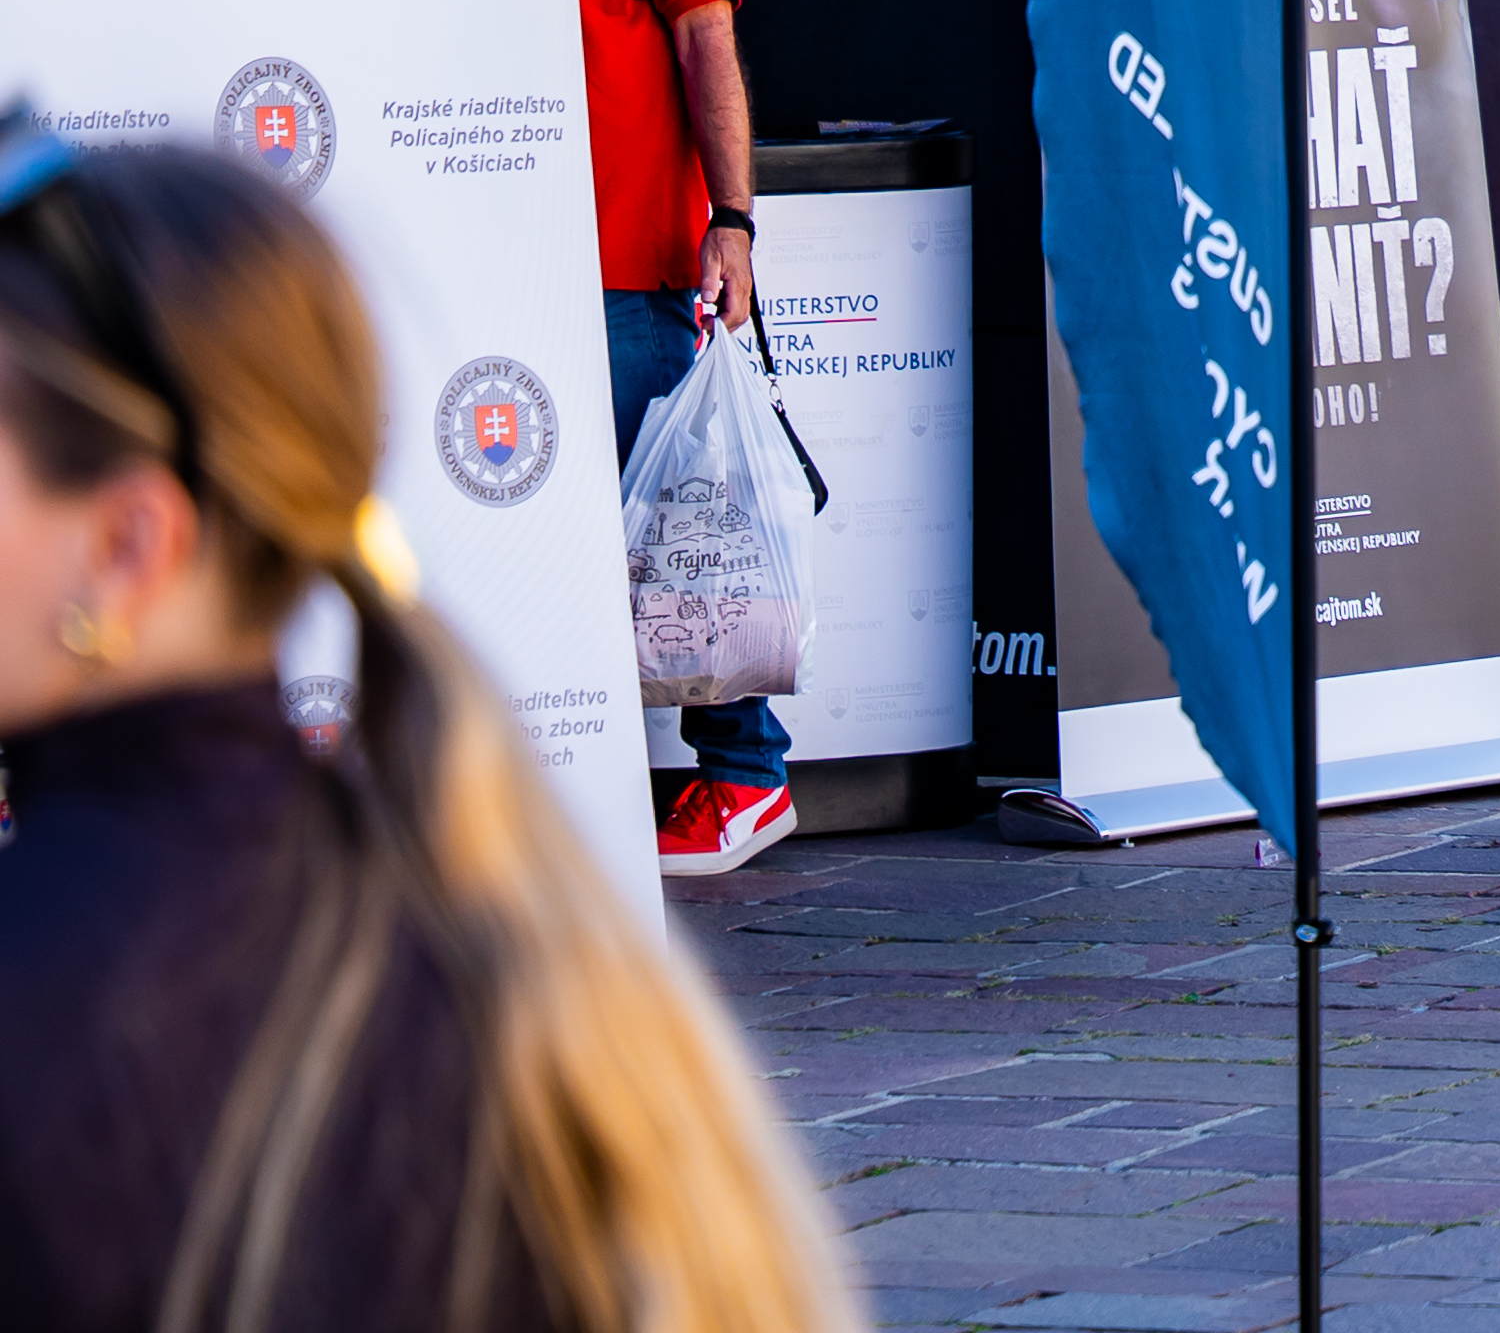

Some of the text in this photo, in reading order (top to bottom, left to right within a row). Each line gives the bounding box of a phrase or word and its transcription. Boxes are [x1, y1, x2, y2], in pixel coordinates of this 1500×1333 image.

[221, 61, 327, 119] POLICAJNÝ ZBOR
[57, 109, 170, 132] riaditeľstvo
[382, 96, 565, 122] Krajské riaditeľstvo
[1308, 26, 1418, 210] HAŤ
[390, 124, 563, 149] Policajného zboru
[426, 152, 536, 174] v Košiciach
[759, 295, 878, 316] NISTERSTVO
[857, 349, 955, 372] REPUBLIKY
[440, 360, 548, 418] POLICAJNÝ ZBOR
[439, 428, 554, 502] SLOVENSKEJ REPUBLIKY
[1363, 531, 1420, 550] REPUBLIKY
[667, 549, 722, 580] Fajne
[508, 688, 608, 713] iaditeľstvo
[548, 717, 605, 738] zboru
